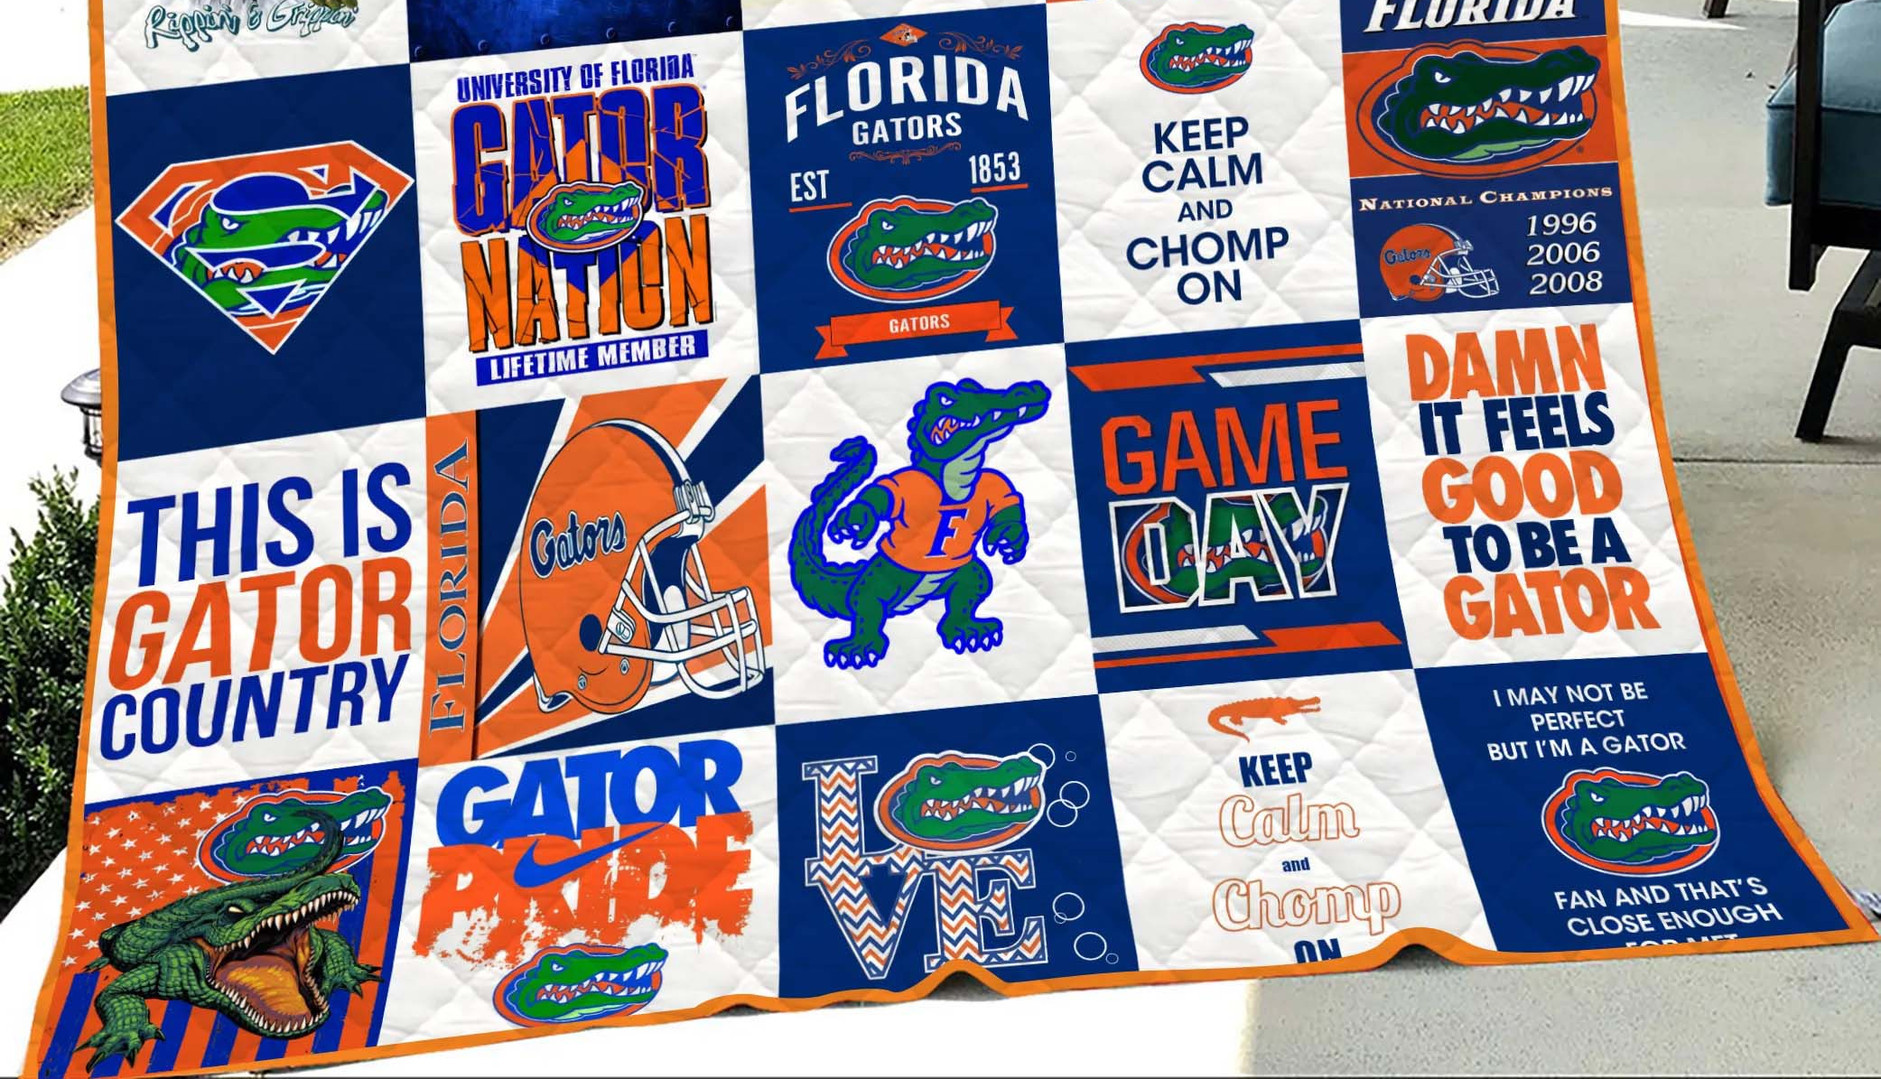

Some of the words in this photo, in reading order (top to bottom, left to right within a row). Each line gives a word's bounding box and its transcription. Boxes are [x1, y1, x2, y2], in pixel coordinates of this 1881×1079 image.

[457, 65, 572, 102] UNIVERSITY
[580, 62, 603, 88] OF
[611, 53, 694, 87] FLORIDA
[785, 54, 1029, 144] FLORIDA
[852, 112, 963, 146] GATORS
[1154, 116, 1249, 155] KEEP
[450, 82, 710, 237] GATOR
[969, 151, 1021, 185] 1853
[1142, 152, 1263, 193] CALM
[790, 170, 830, 203] EST
[1177, 199, 1234, 222] AND
[1126, 226, 1289, 271] CHOMP
[1526, 212, 1597, 238] 1996
[1526, 242, 1601, 266] 2006
[460, 214, 714, 353] NATION
[1177, 269, 1242, 305] ON
[1529, 270, 1603, 295] 2008
[889, 313, 951, 334] GATORS
[490, 347, 588, 381] LIFETIME
[597, 334, 696, 366] MEMBER
[1405, 323, 1607, 402] DAMN
[1100, 399, 1349, 496] GAME
[1418, 401, 1463, 456] IT
[1482, 391, 1615, 452] FEELS
[1421, 450, 1623, 525] GOOD
[127, 476, 314, 588] THIS
[342, 462, 412, 558] IS
[530, 510, 627, 578] Gators
[924, 508, 969, 558] F
[1108, 482, 1350, 614] DAY
[1442, 523, 1511, 574] TO
[1516, 519, 1583, 569] BE
[1591, 517, 1632, 564] A
[429, 438, 469, 735] FLORIDA
[1443, 566, 1662, 641] GATOR
[108, 557, 412, 692] GATOR
[99, 653, 410, 761] COUNTRY
[1493, 689, 1501, 707] I
[1508, 686, 1560, 707] MAY
[1566, 683, 1613, 704] NOT
[1620, 682, 1649, 701] BE
[1530, 709, 1625, 732] PERFECT
[1238, 751, 1313, 788] KEEP
[1487, 740, 1528, 761] BUT
[1536, 739, 1573, 759] I'M
[1580, 737, 1598, 756] A
[1602, 732, 1687, 755] GATOR
[436, 738, 743, 850] GATOR
[1219, 793, 1360, 848] Calm
[1282, 857, 1311, 872] and
[412, 810, 754, 972] PRIDE
[1213, 878, 1402, 936] Chomp
[1554, 888, 1607, 910] FAN
[1615, 884, 1670, 907] AND
[1675, 876, 1769, 901] THAT'S
[1567, 915, 1654, 937] CLOSE
[1658, 903, 1784, 932] ENOUGH
